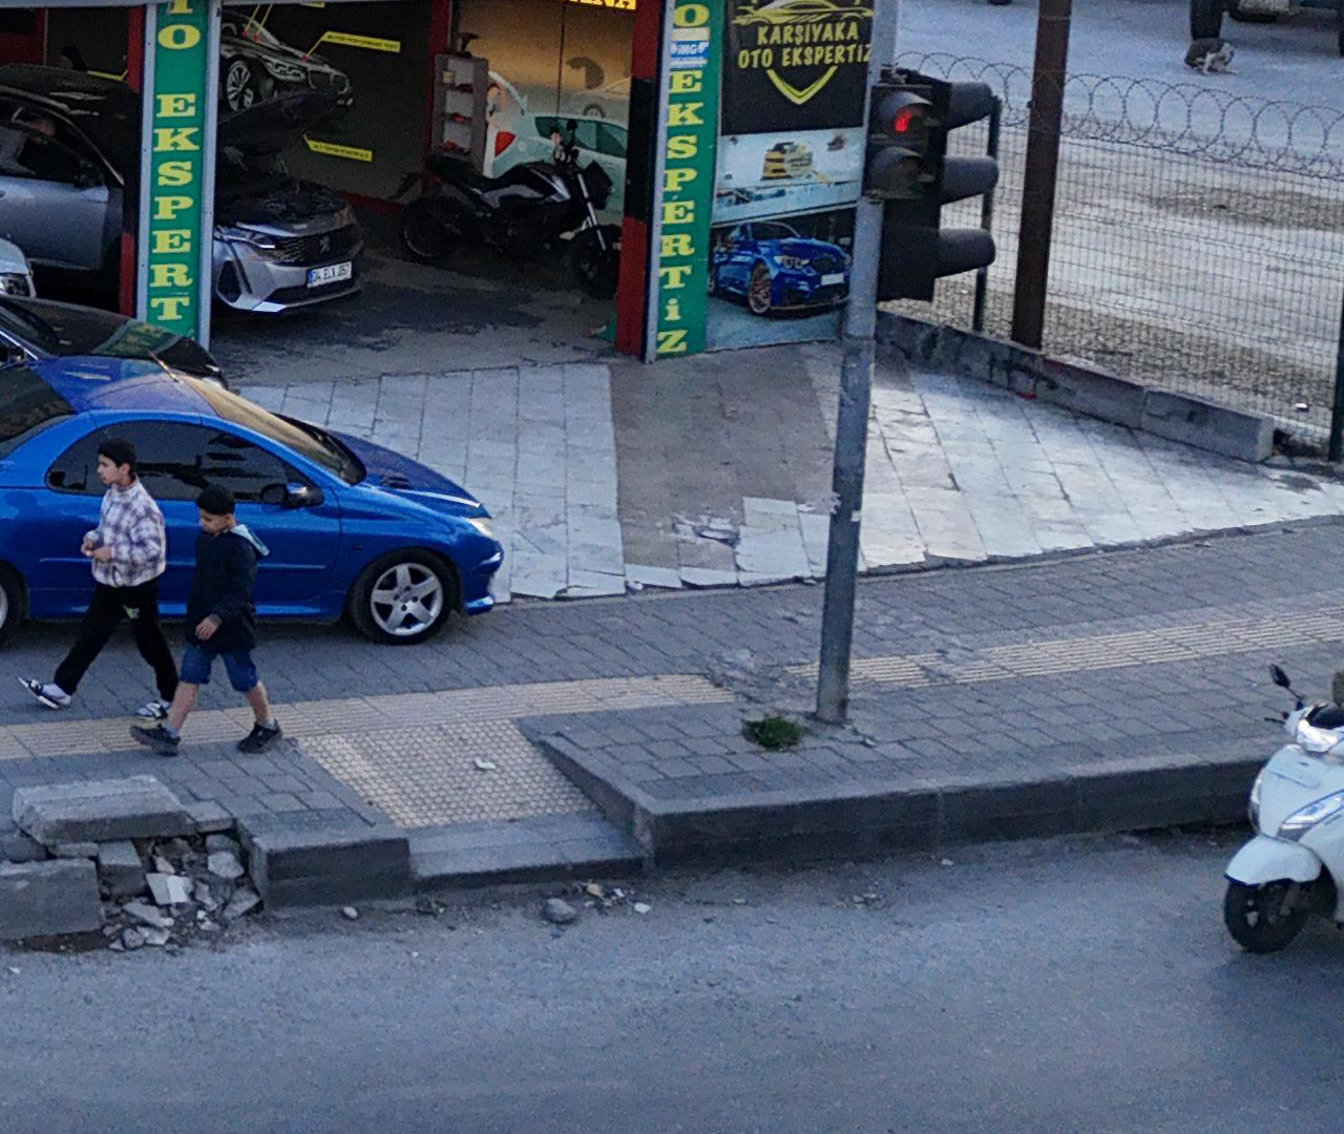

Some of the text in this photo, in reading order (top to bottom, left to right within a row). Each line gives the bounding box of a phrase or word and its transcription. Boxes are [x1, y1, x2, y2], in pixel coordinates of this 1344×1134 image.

[756, 21, 859, 46] KARŞIYAKA
[737, 48, 773, 69] OTO
[149, 92, 200, 323] EKSPERT
